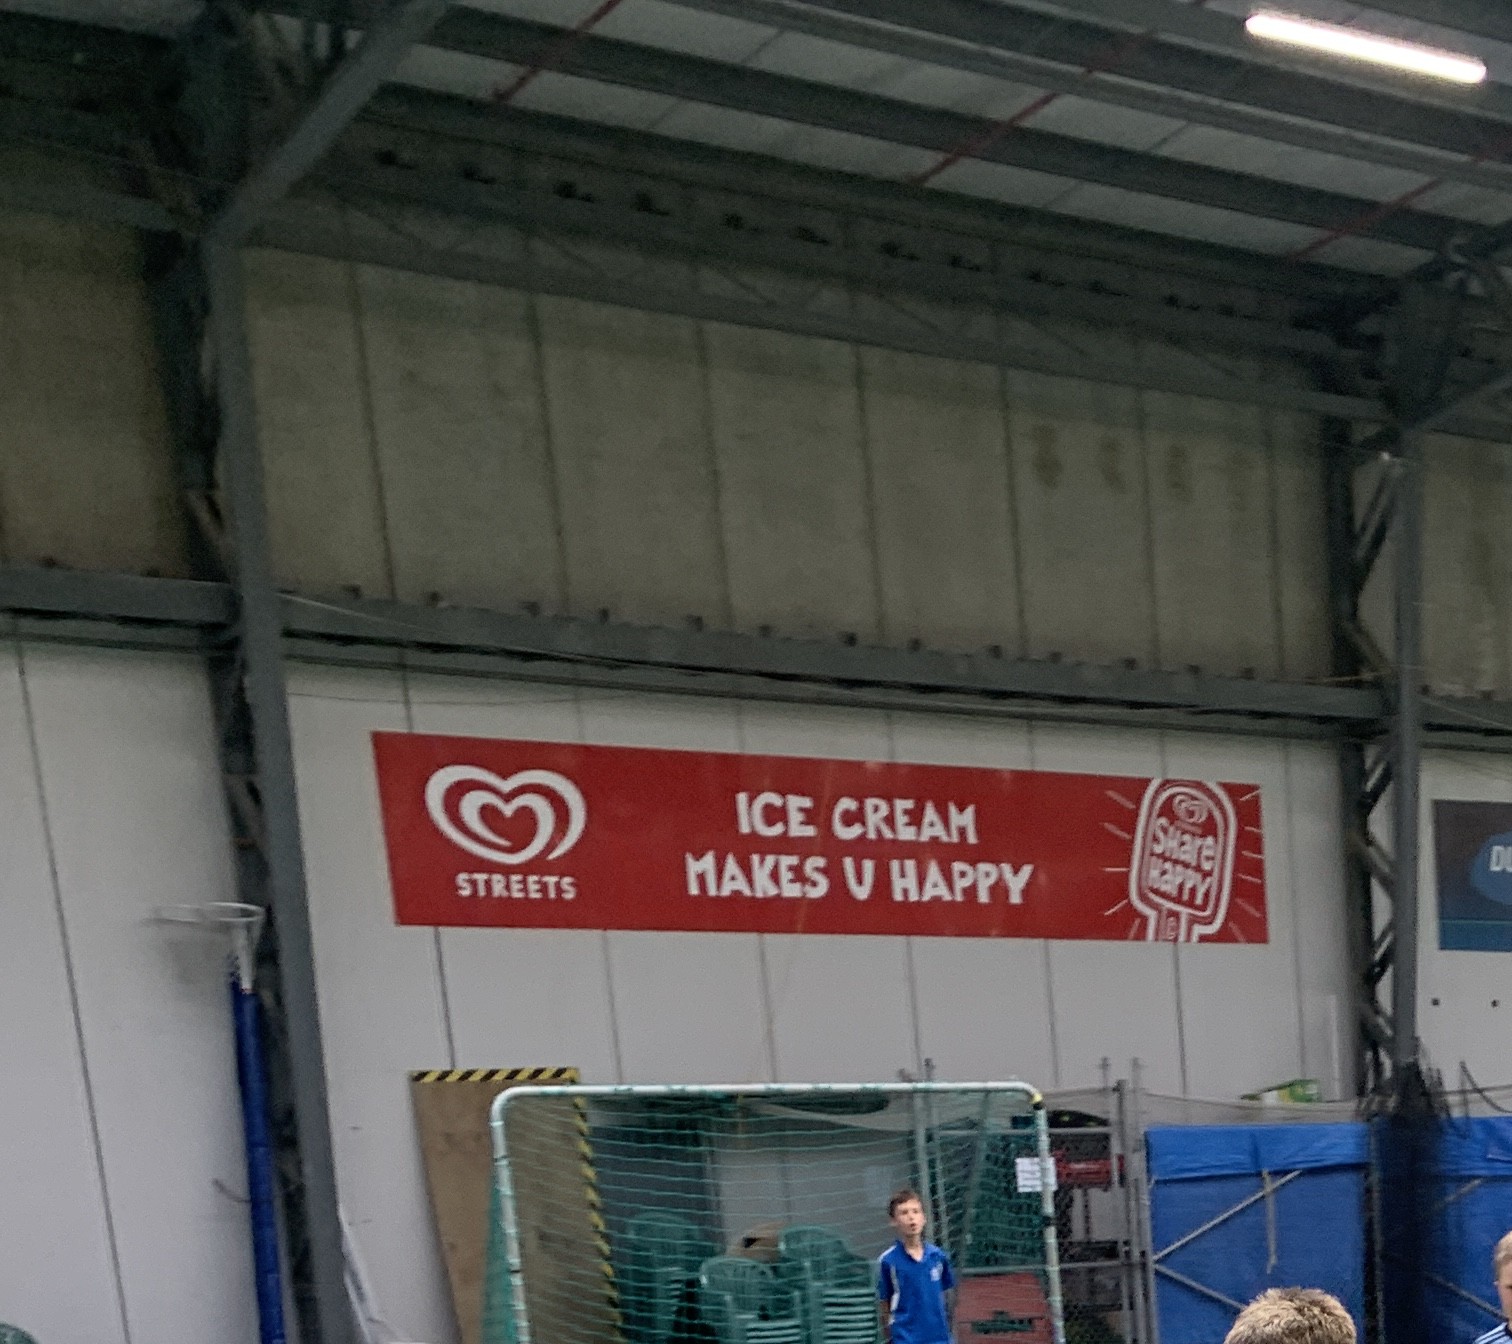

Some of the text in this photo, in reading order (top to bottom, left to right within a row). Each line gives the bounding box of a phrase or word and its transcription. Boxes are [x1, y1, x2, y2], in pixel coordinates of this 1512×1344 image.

[735, 791, 978, 845] ICE CREAM
[455, 871, 577, 900] STREETS
[685, 850, 1034, 905] MAKES U HAPPY
